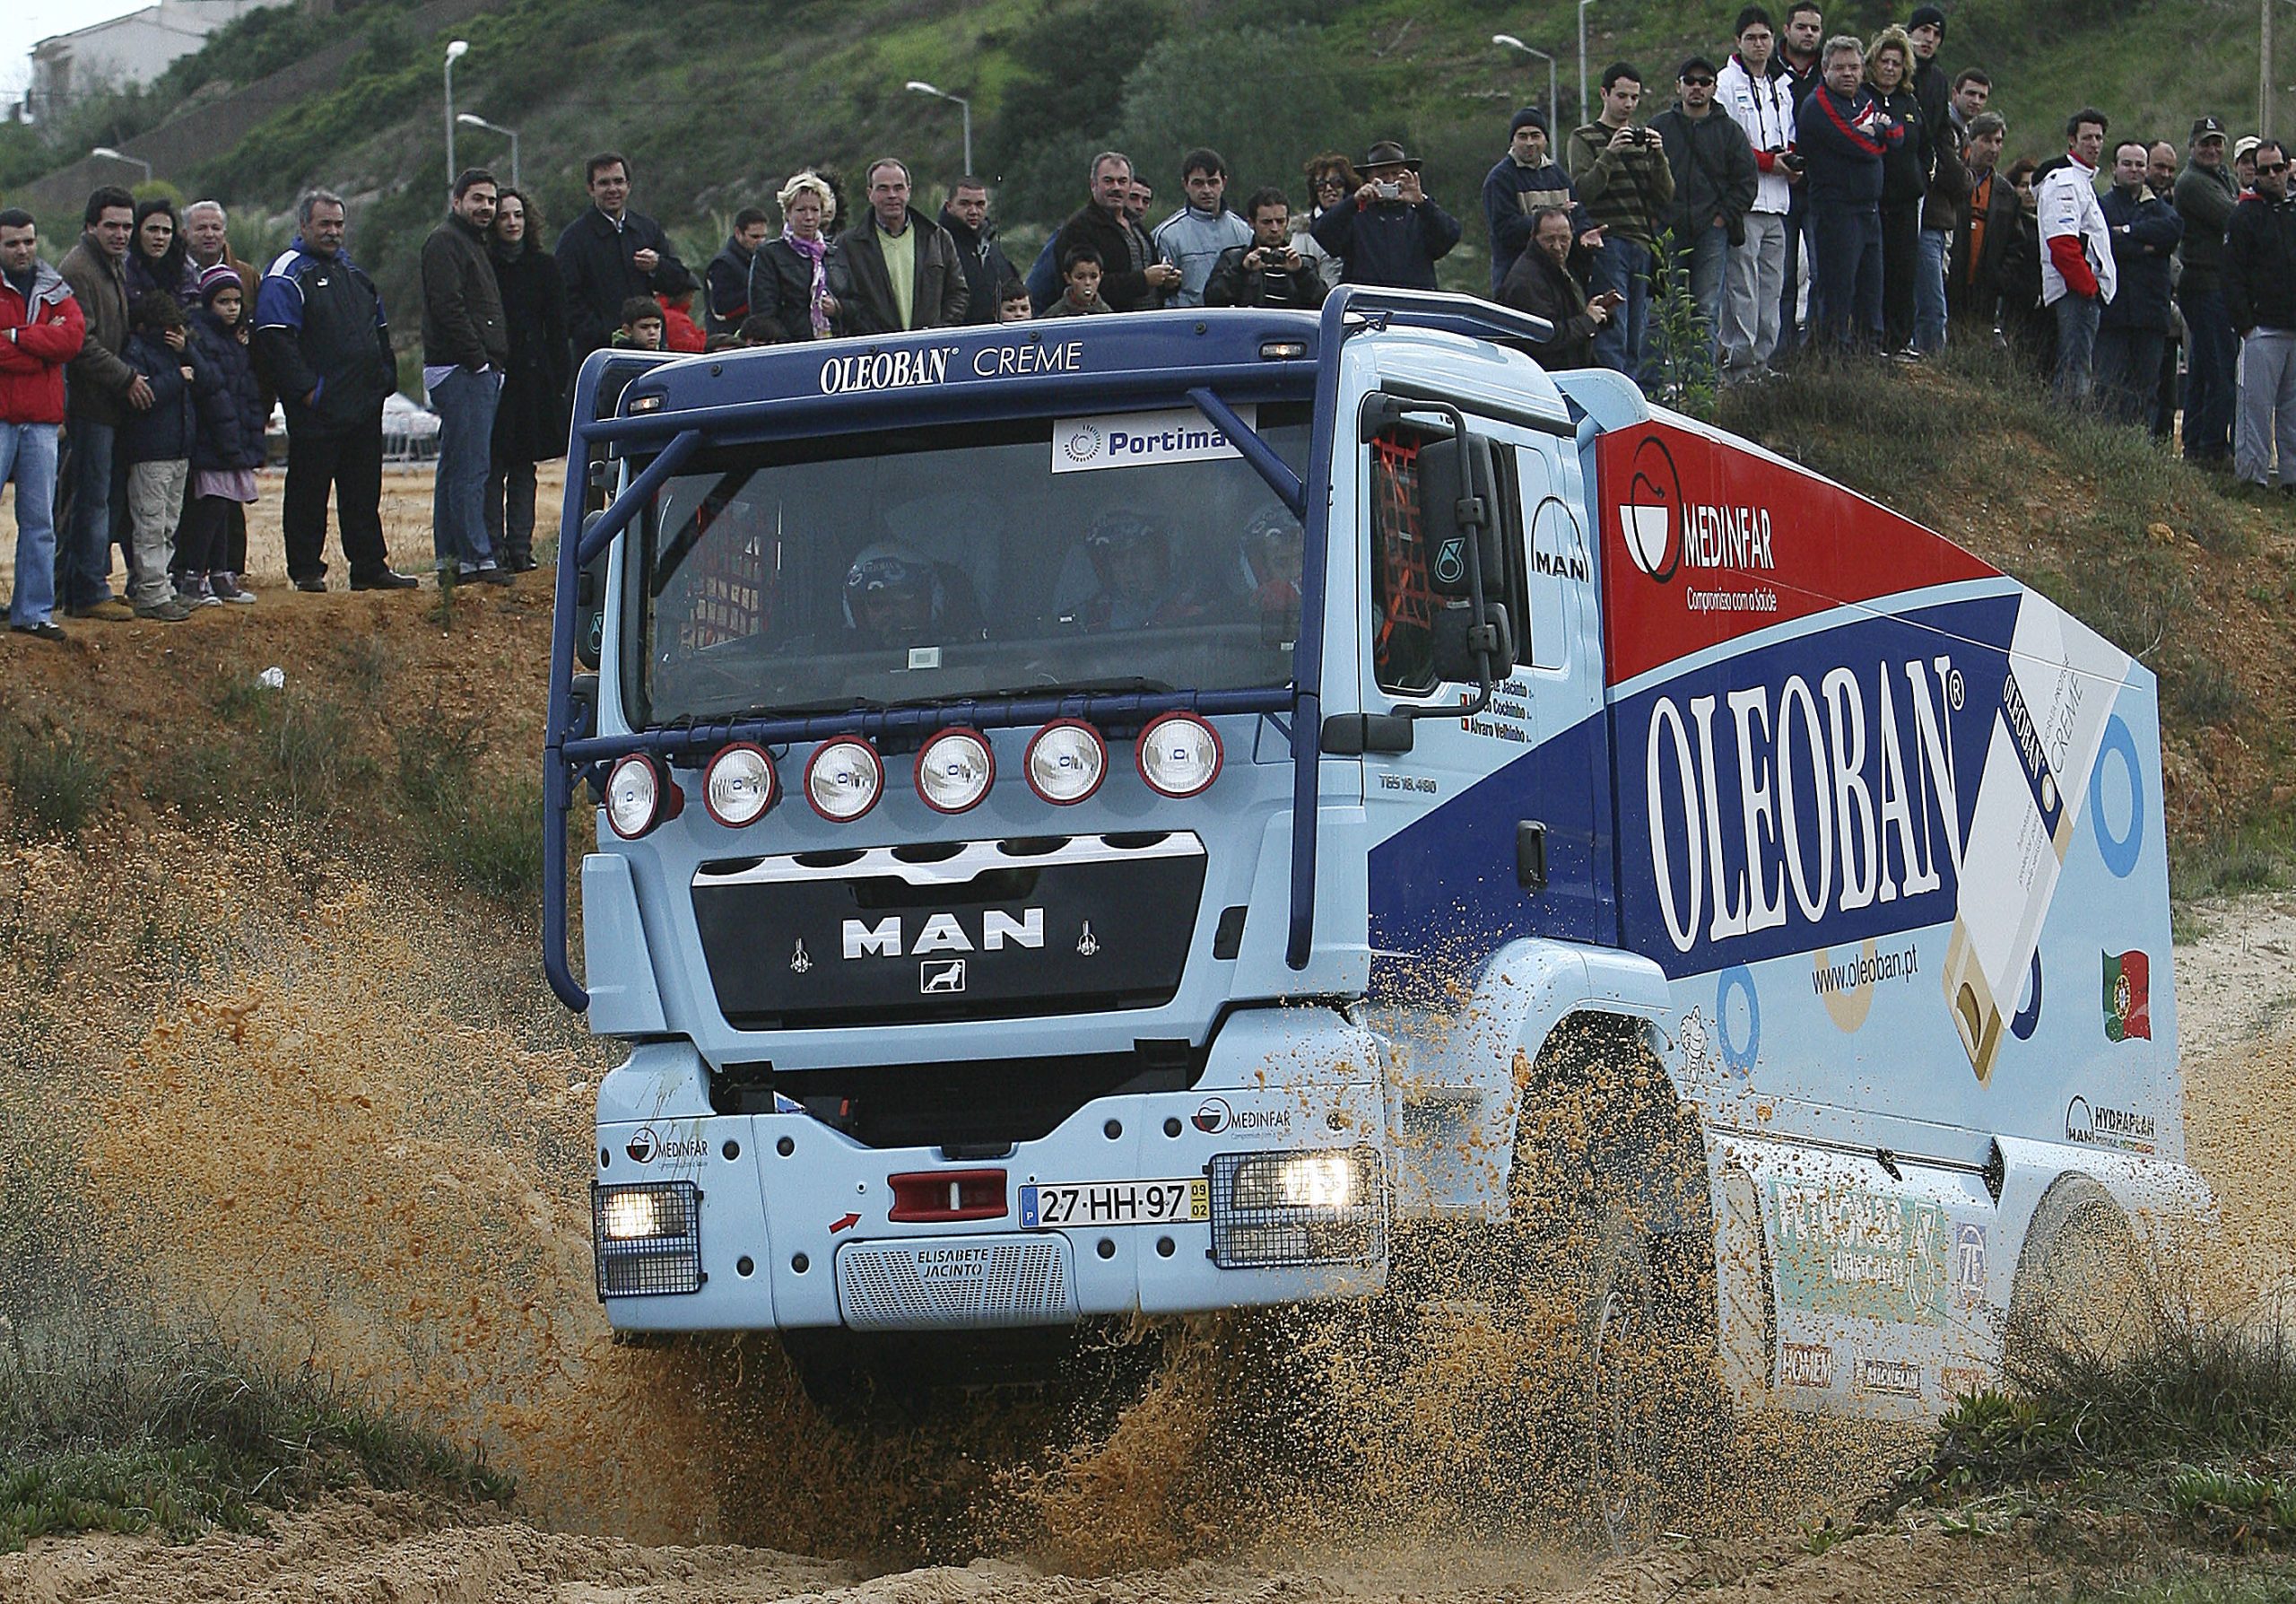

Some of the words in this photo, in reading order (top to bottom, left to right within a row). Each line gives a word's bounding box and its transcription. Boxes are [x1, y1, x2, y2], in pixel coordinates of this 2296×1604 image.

[973, 342, 1083, 377] CREME
[1683, 502, 1776, 571] MEDINFAR
[1535, 550, 1585, 582] MAN
[2050, 671, 2083, 773] CREME
[842, 907, 1045, 960] MAN
[1812, 943, 1918, 995] www.oleoban.pt
[1231, 1111, 1292, 1129] MEDINFAR
[657, 1140, 709, 1158] MEDINFAR
[1191, 1183, 1206, 1196] 09
[1025, 1212, 1034, 1222] P
[1191, 1204, 1207, 1216] 02
[918, 1248, 988, 1264] ELISABETE
[924, 1263, 982, 1278] JACINTO
